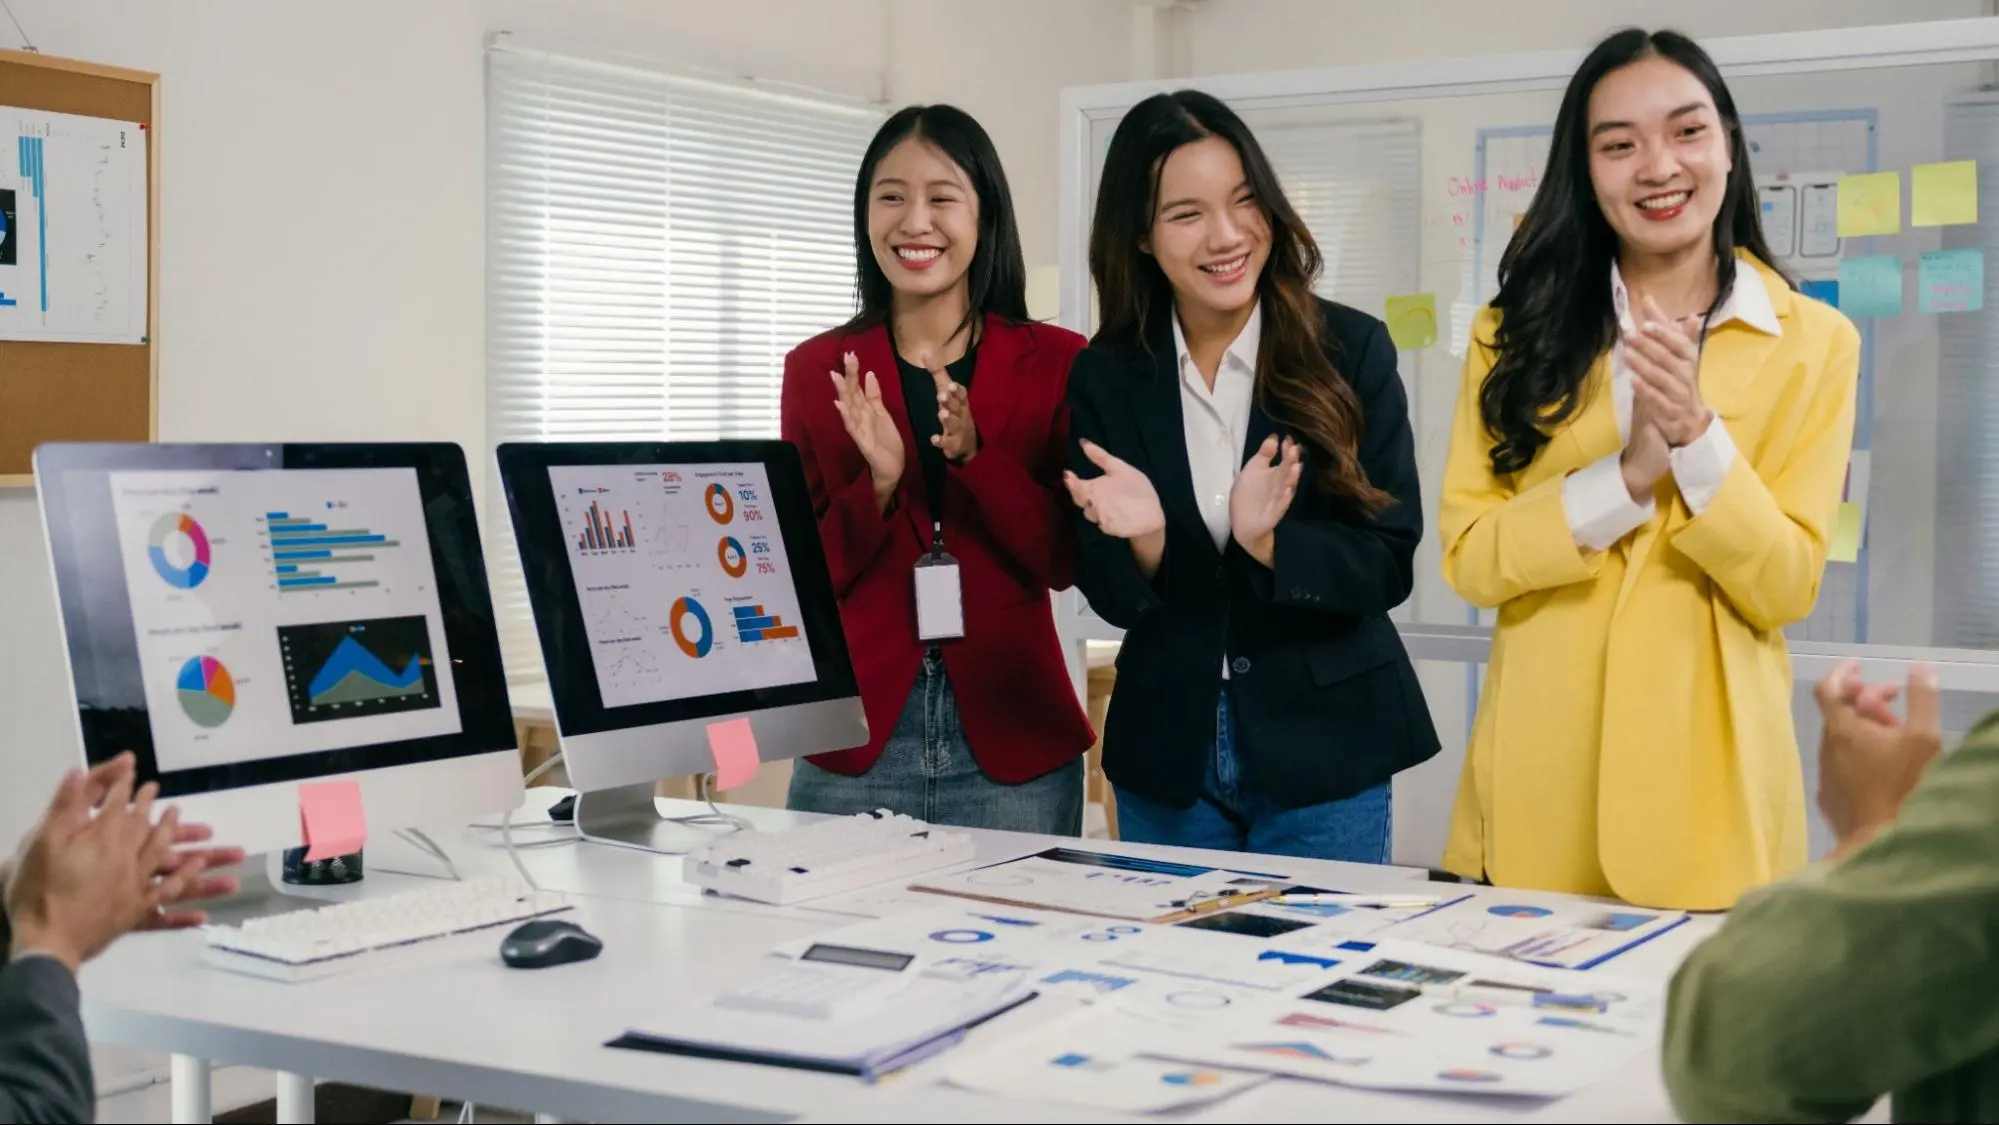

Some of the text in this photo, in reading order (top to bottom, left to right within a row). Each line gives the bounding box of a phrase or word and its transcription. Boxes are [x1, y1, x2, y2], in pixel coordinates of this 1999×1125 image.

[738, 490, 758, 501] 10%
[743, 510, 763, 521] 90%
[751, 542, 770, 553] 25%
[756, 562, 775, 574] 75%
